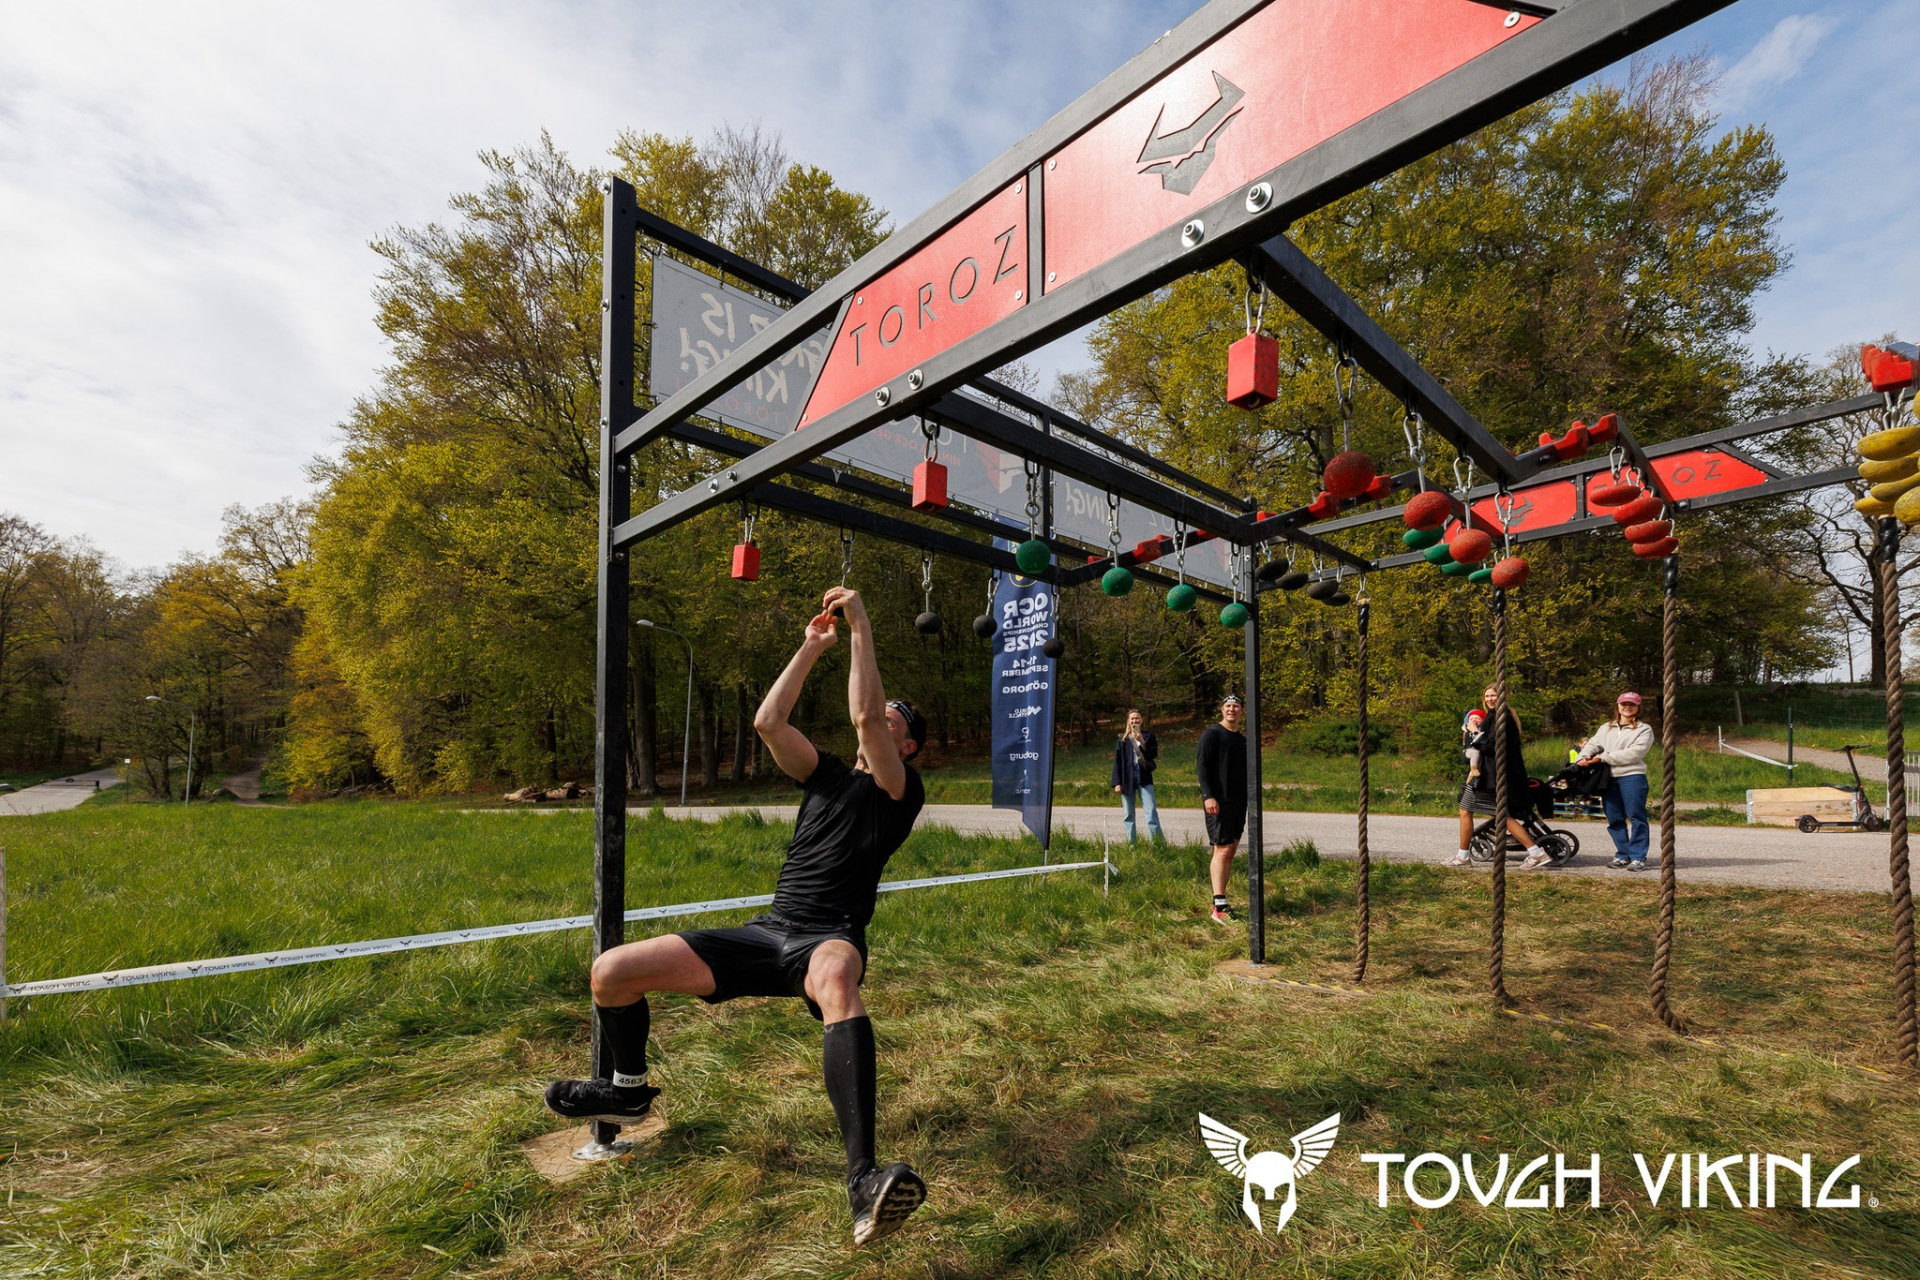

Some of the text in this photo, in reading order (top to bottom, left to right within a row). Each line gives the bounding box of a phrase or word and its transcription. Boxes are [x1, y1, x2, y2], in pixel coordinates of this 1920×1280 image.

[850, 224, 1020, 367] TOROZ
[120, 973, 149, 982] TOUGH
[29, 980, 91, 992] TOUGH VIKING
